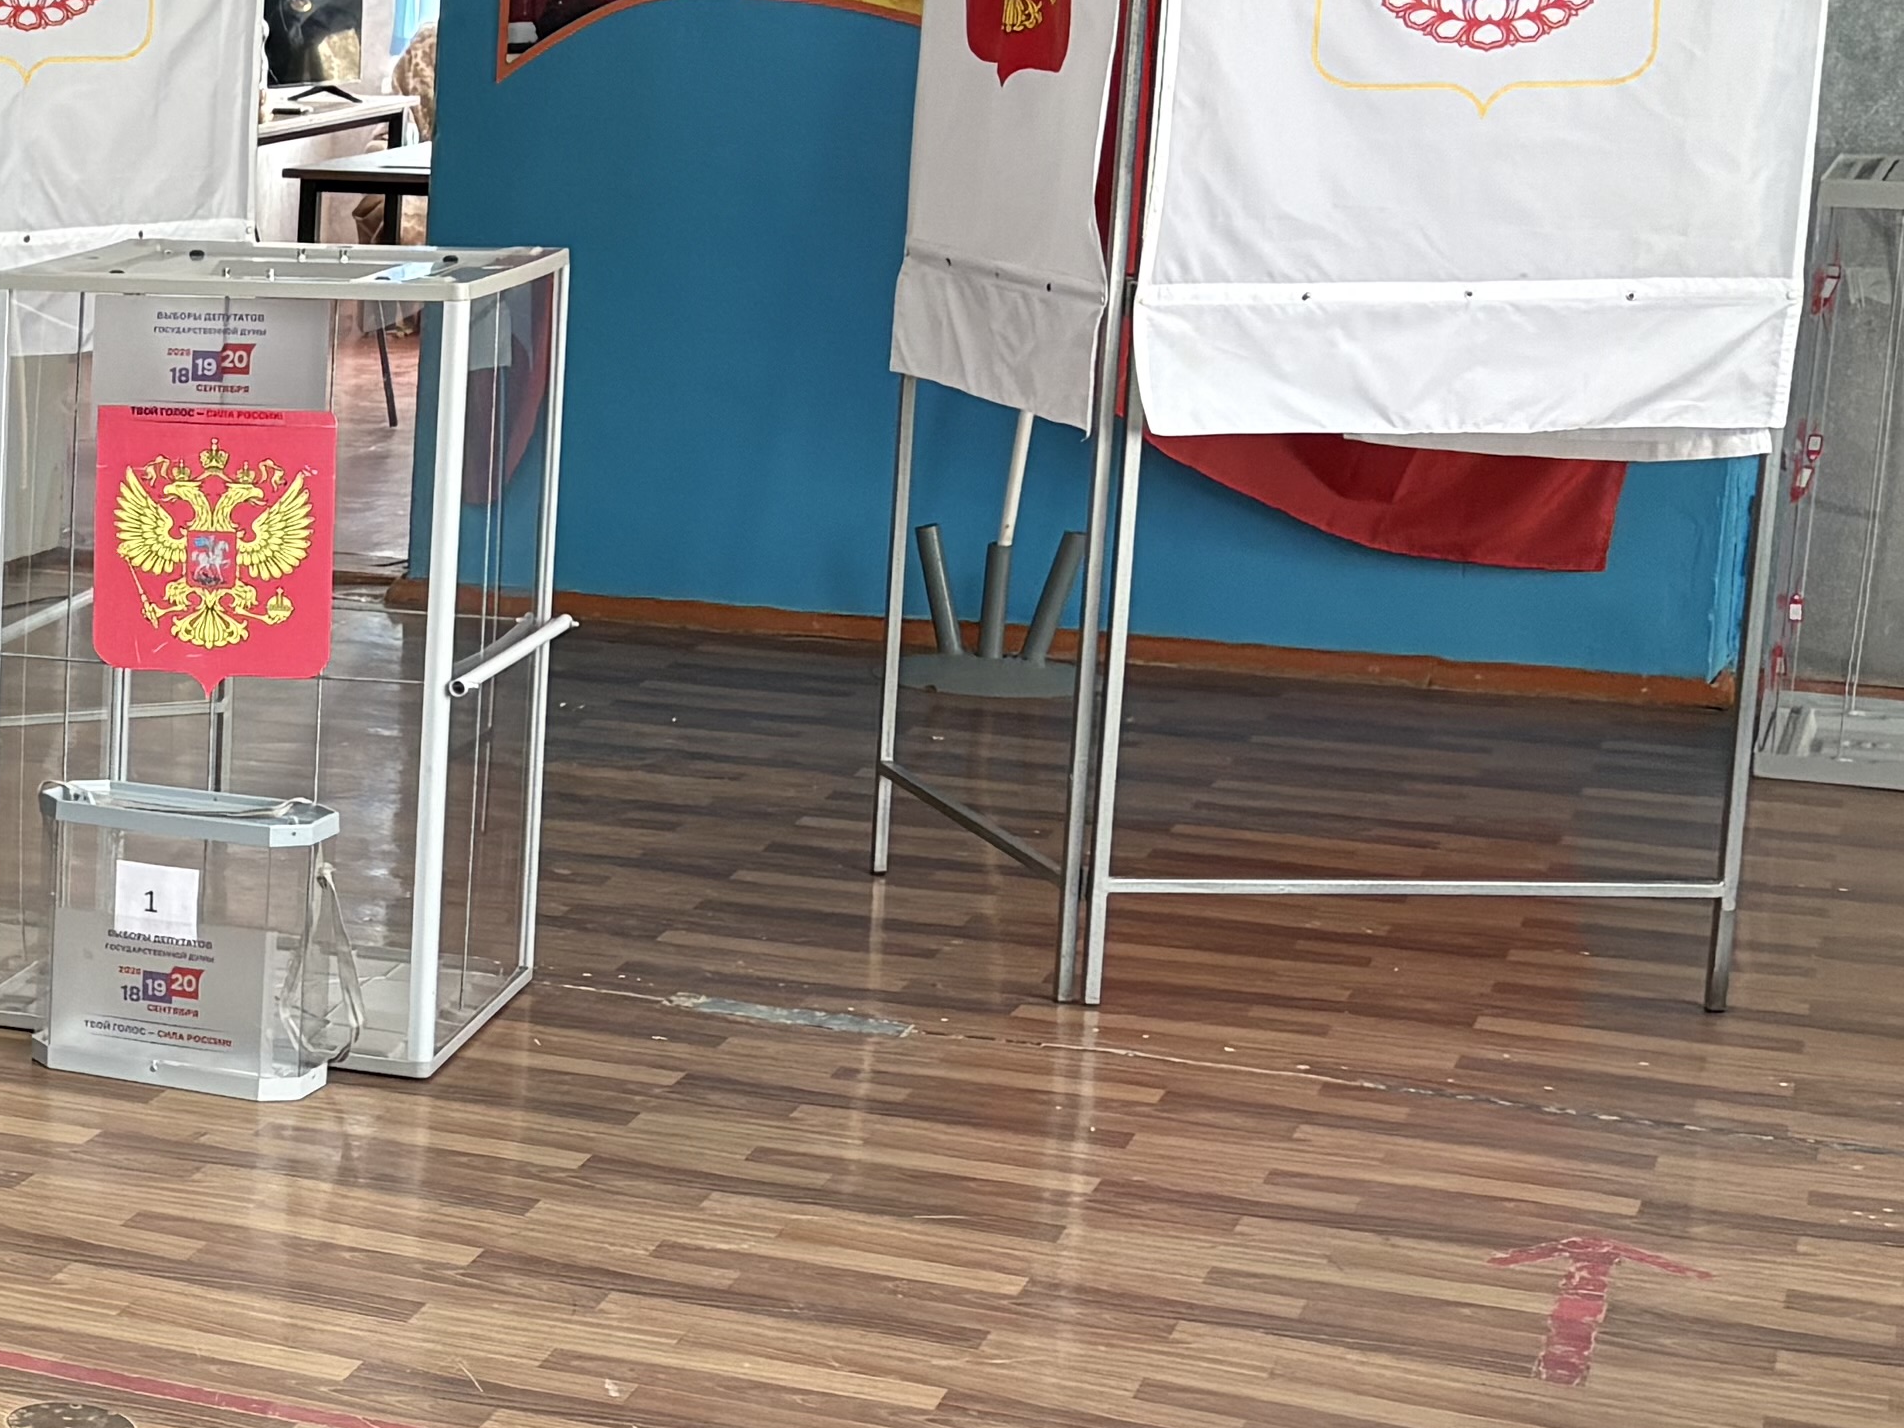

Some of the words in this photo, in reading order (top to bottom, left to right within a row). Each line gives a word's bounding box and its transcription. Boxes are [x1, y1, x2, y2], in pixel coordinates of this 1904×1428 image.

[156, 311, 202, 321] ВЫБОРЫ
[204, 313, 265, 323] ДЕПУТАТОВ
[153, 325, 238, 336] ГОСУДАРСТВЕННОЙ
[240, 328, 267, 337] ДУМЫ
[169, 367, 190, 384] 18
[195, 357, 217, 376] 19
[221, 350, 248, 368] 20
[196, 383, 250, 393] СЕНТЯБРЯ
[130, 406, 158, 417] ТВОЙ
[159, 406, 195, 418] ГОЛОС
[206, 409, 234, 419] СИЛА
[144, 891, 158, 913] 1
[107, 928, 151, 942] ВЫБОРЫ
[153, 935, 213, 950] ДЕПУТАТОВ
[104, 942, 187, 961] ГОСУДАРСТВЕННОЙ
[121, 985, 141, 1002] 18
[145, 979, 167, 997] 19
[171, 974, 196, 992] 20
[146, 1004, 199, 1018] СЕНТЯБРЯ
[84, 1019, 111, 1031] ТВОЙ
[112, 1022, 146, 1036] ГОЛОС
[157, 1030, 184, 1041] СИЛА
